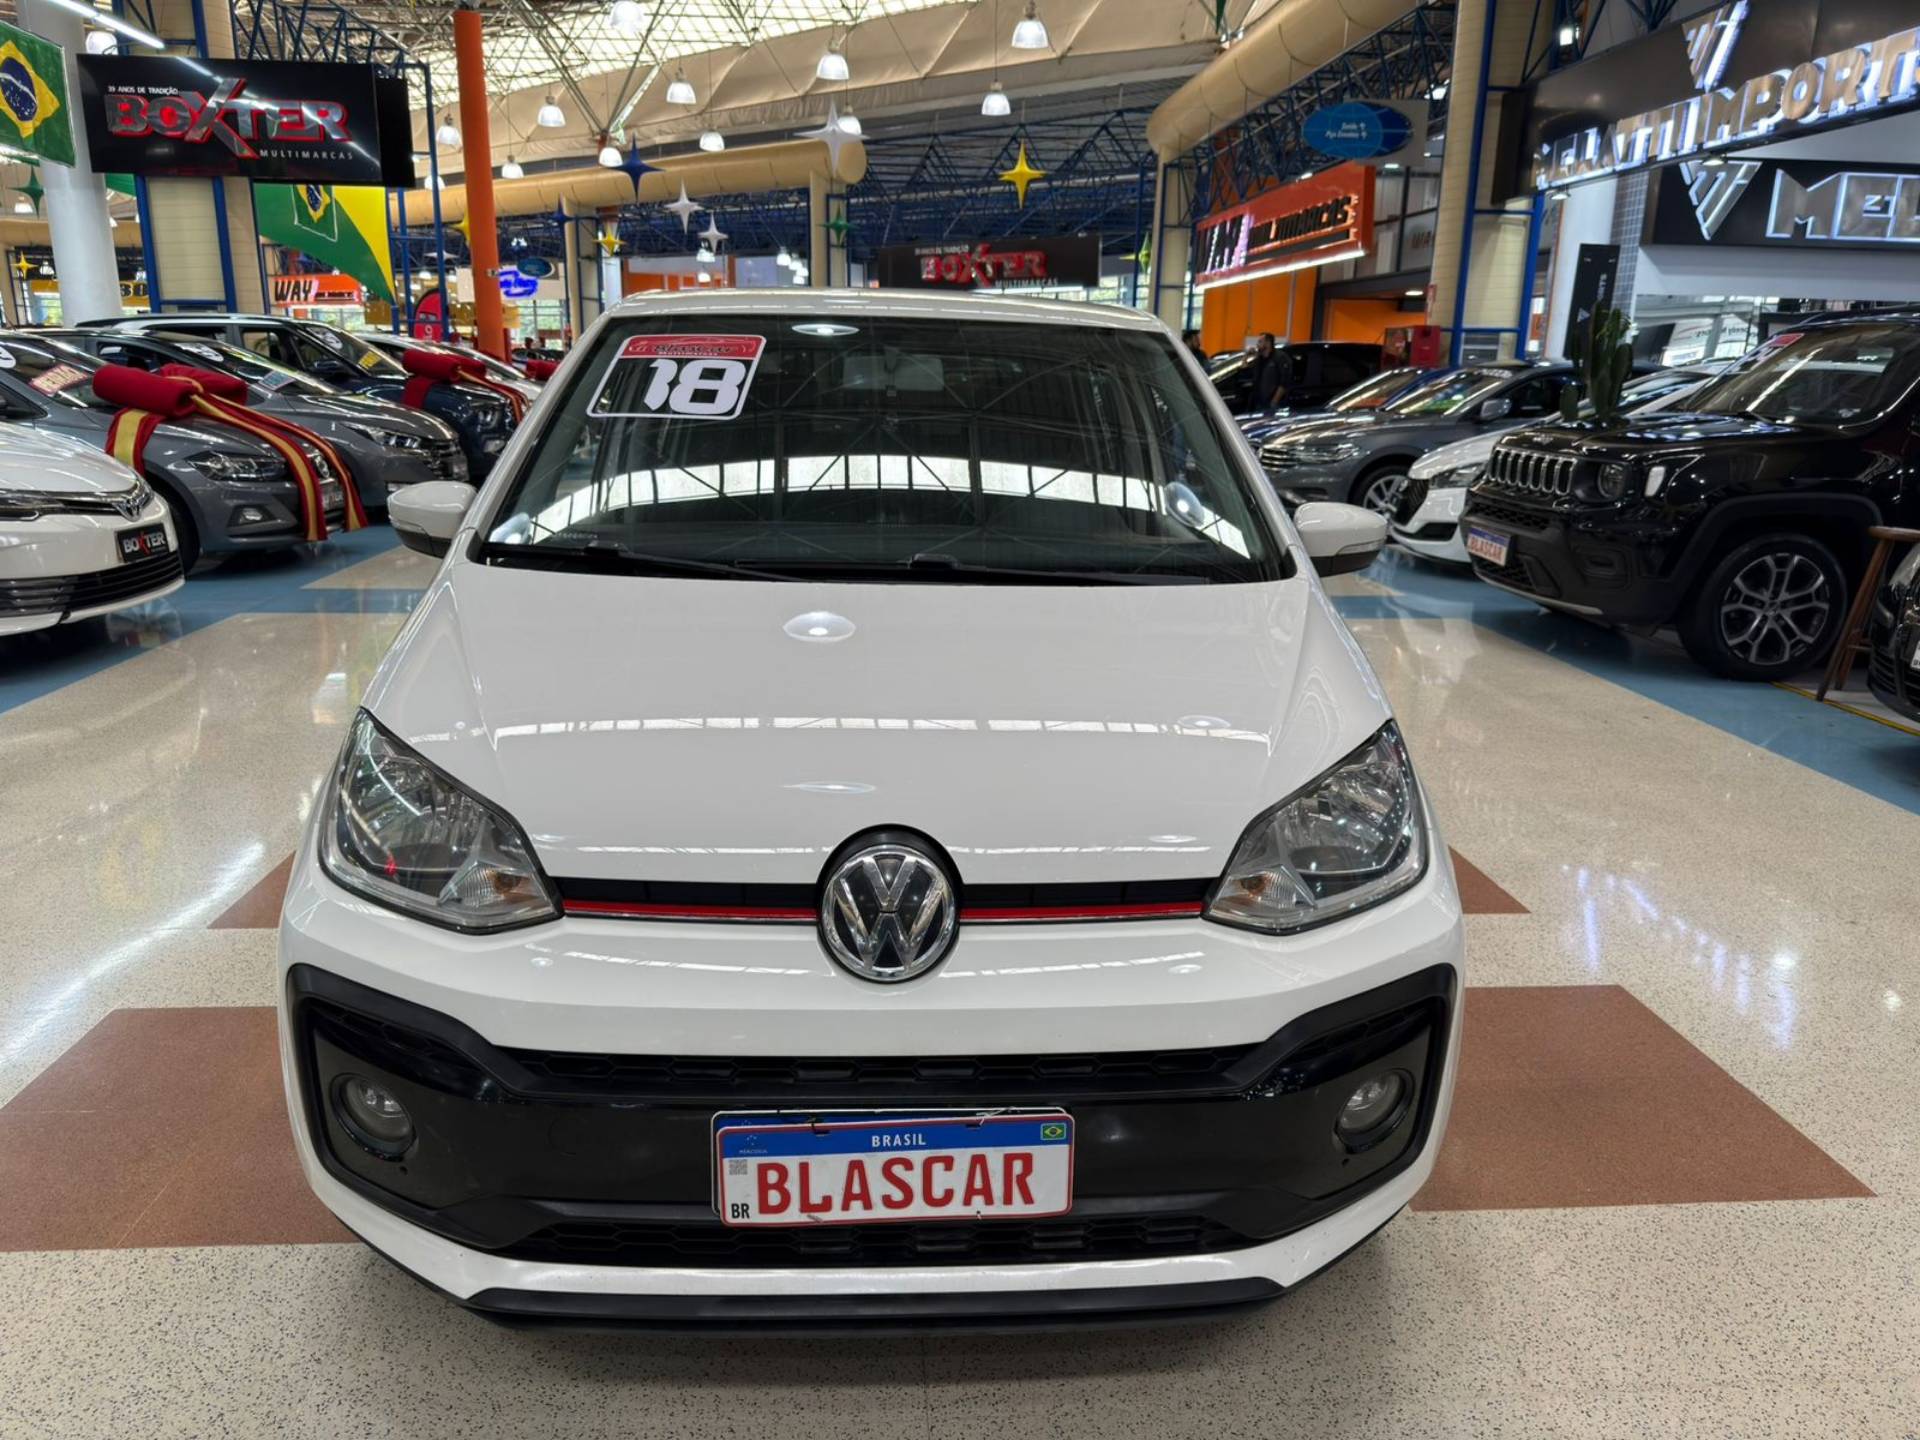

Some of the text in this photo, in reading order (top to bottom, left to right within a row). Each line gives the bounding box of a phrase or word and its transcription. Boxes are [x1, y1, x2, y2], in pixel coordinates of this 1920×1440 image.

[104, 78, 351, 159] BOXTER
[259, 150, 354, 160] MULTIMARCAS
[921, 243, 1048, 288] BOXTER
[274, 279, 314, 302] WAY
[995, 278, 1058, 289] MULTIMARCAS
[644, 358, 747, 415] 18
[123, 531, 166, 556] BOXTER
[871, 1133, 927, 1148] BRASIL
[757, 1153, 1035, 1216] BLASCAR
[731, 1203, 750, 1219] BR
